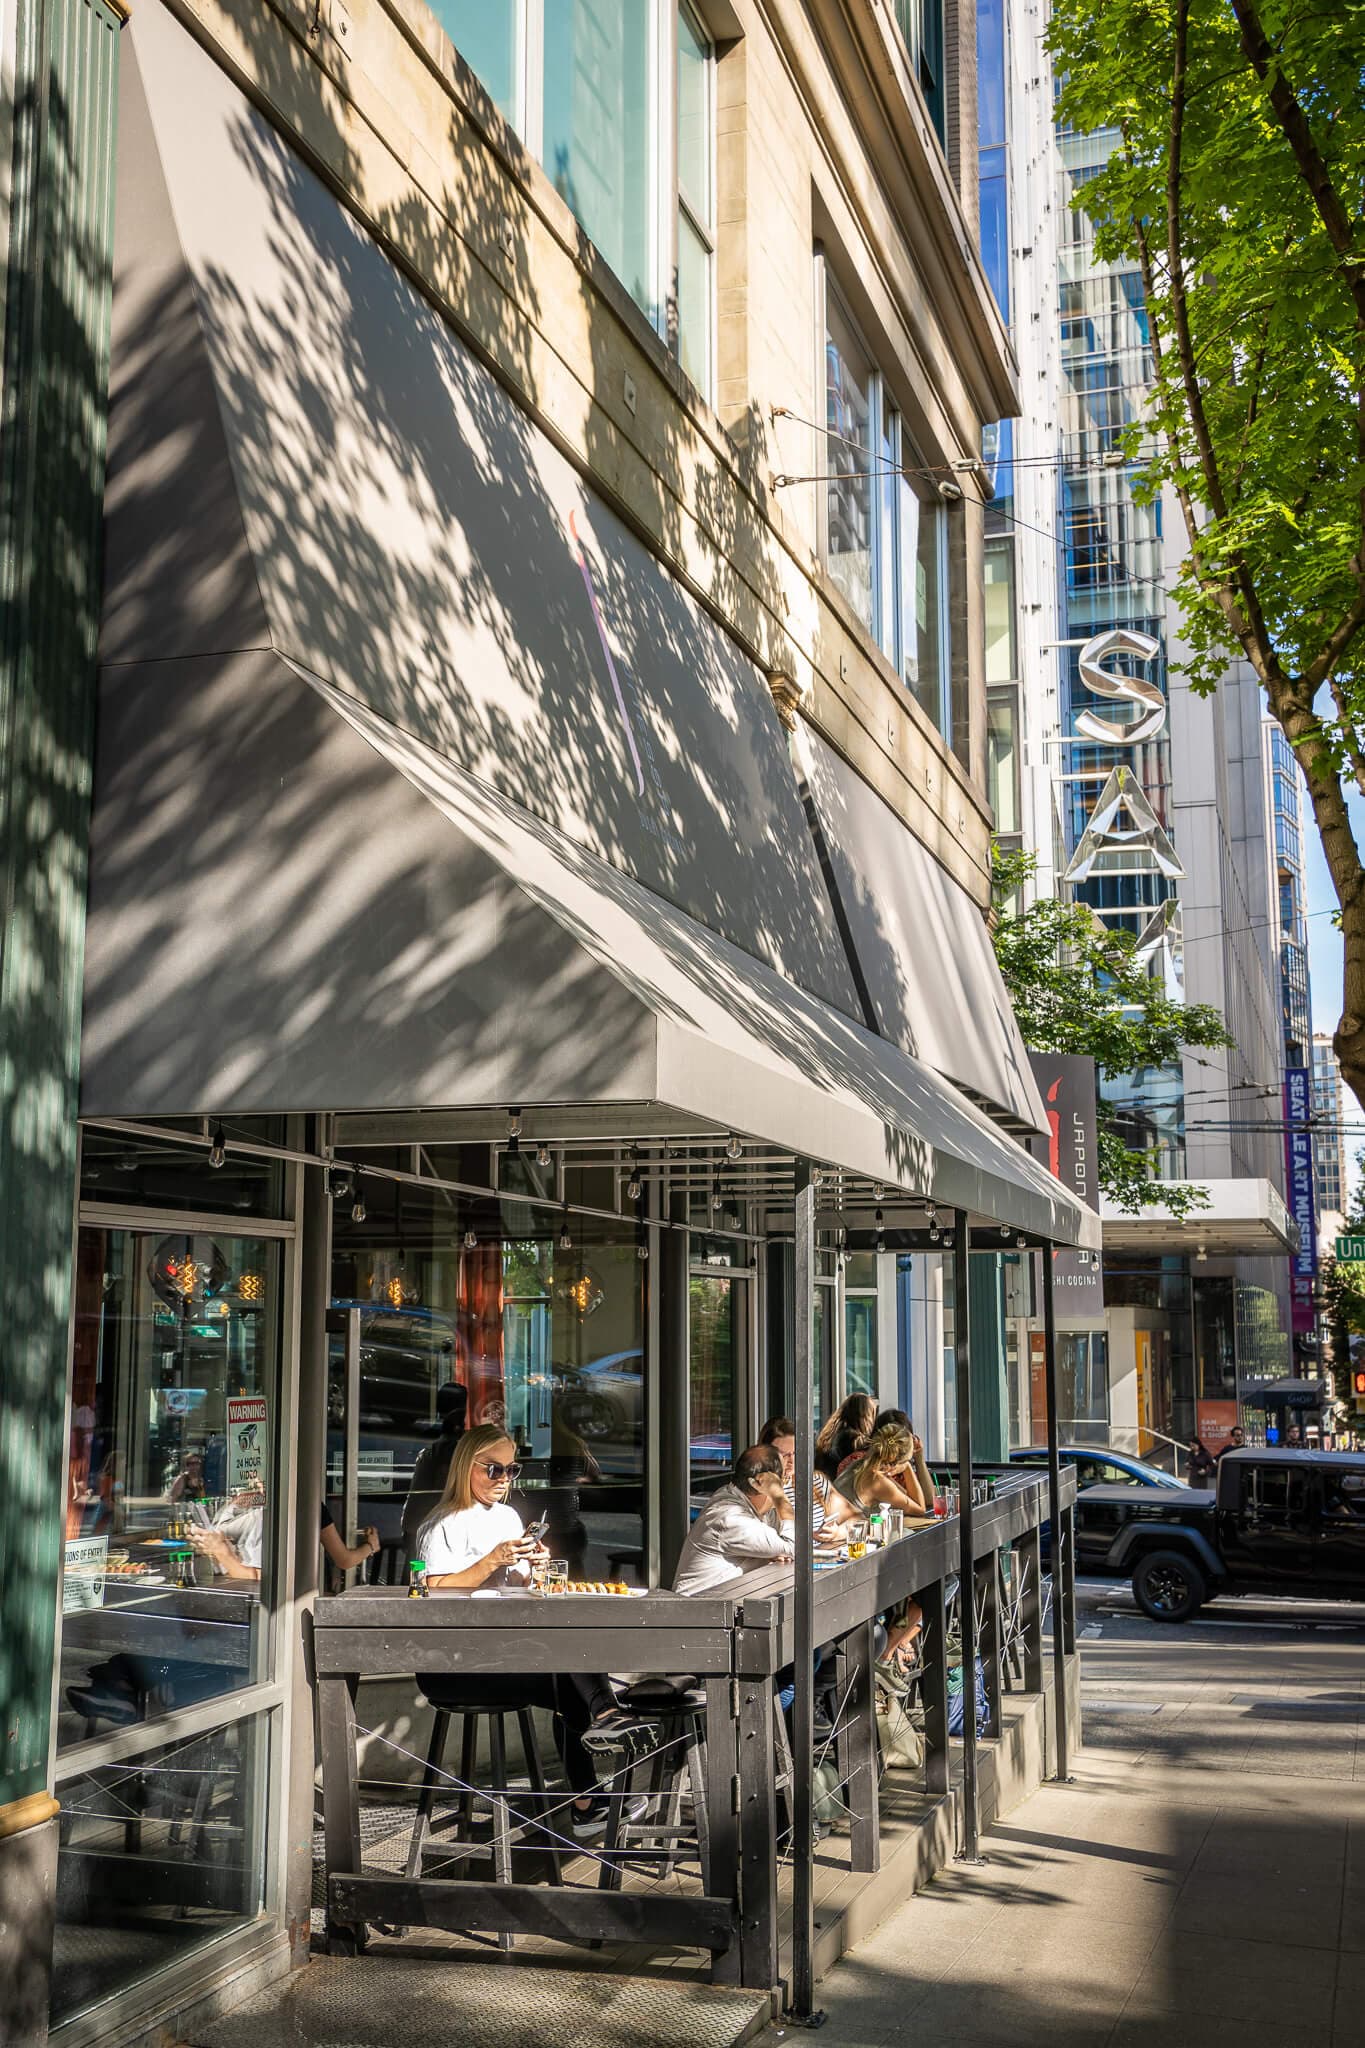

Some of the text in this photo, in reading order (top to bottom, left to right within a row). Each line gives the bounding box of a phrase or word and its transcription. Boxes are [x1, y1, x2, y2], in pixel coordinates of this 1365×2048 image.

[1293, 1155, 1308, 1192] ART
[1295, 1195, 1313, 1272] MUSEUM
[1067, 1275, 1097, 1287] COCINA
[229, 1404, 266, 1420] WARNING
[236, 1457, 261, 1469] 24 HOUR
[240, 1469, 258, 1480] VIDEO
[87, 1546, 103, 1558] ENTRY
